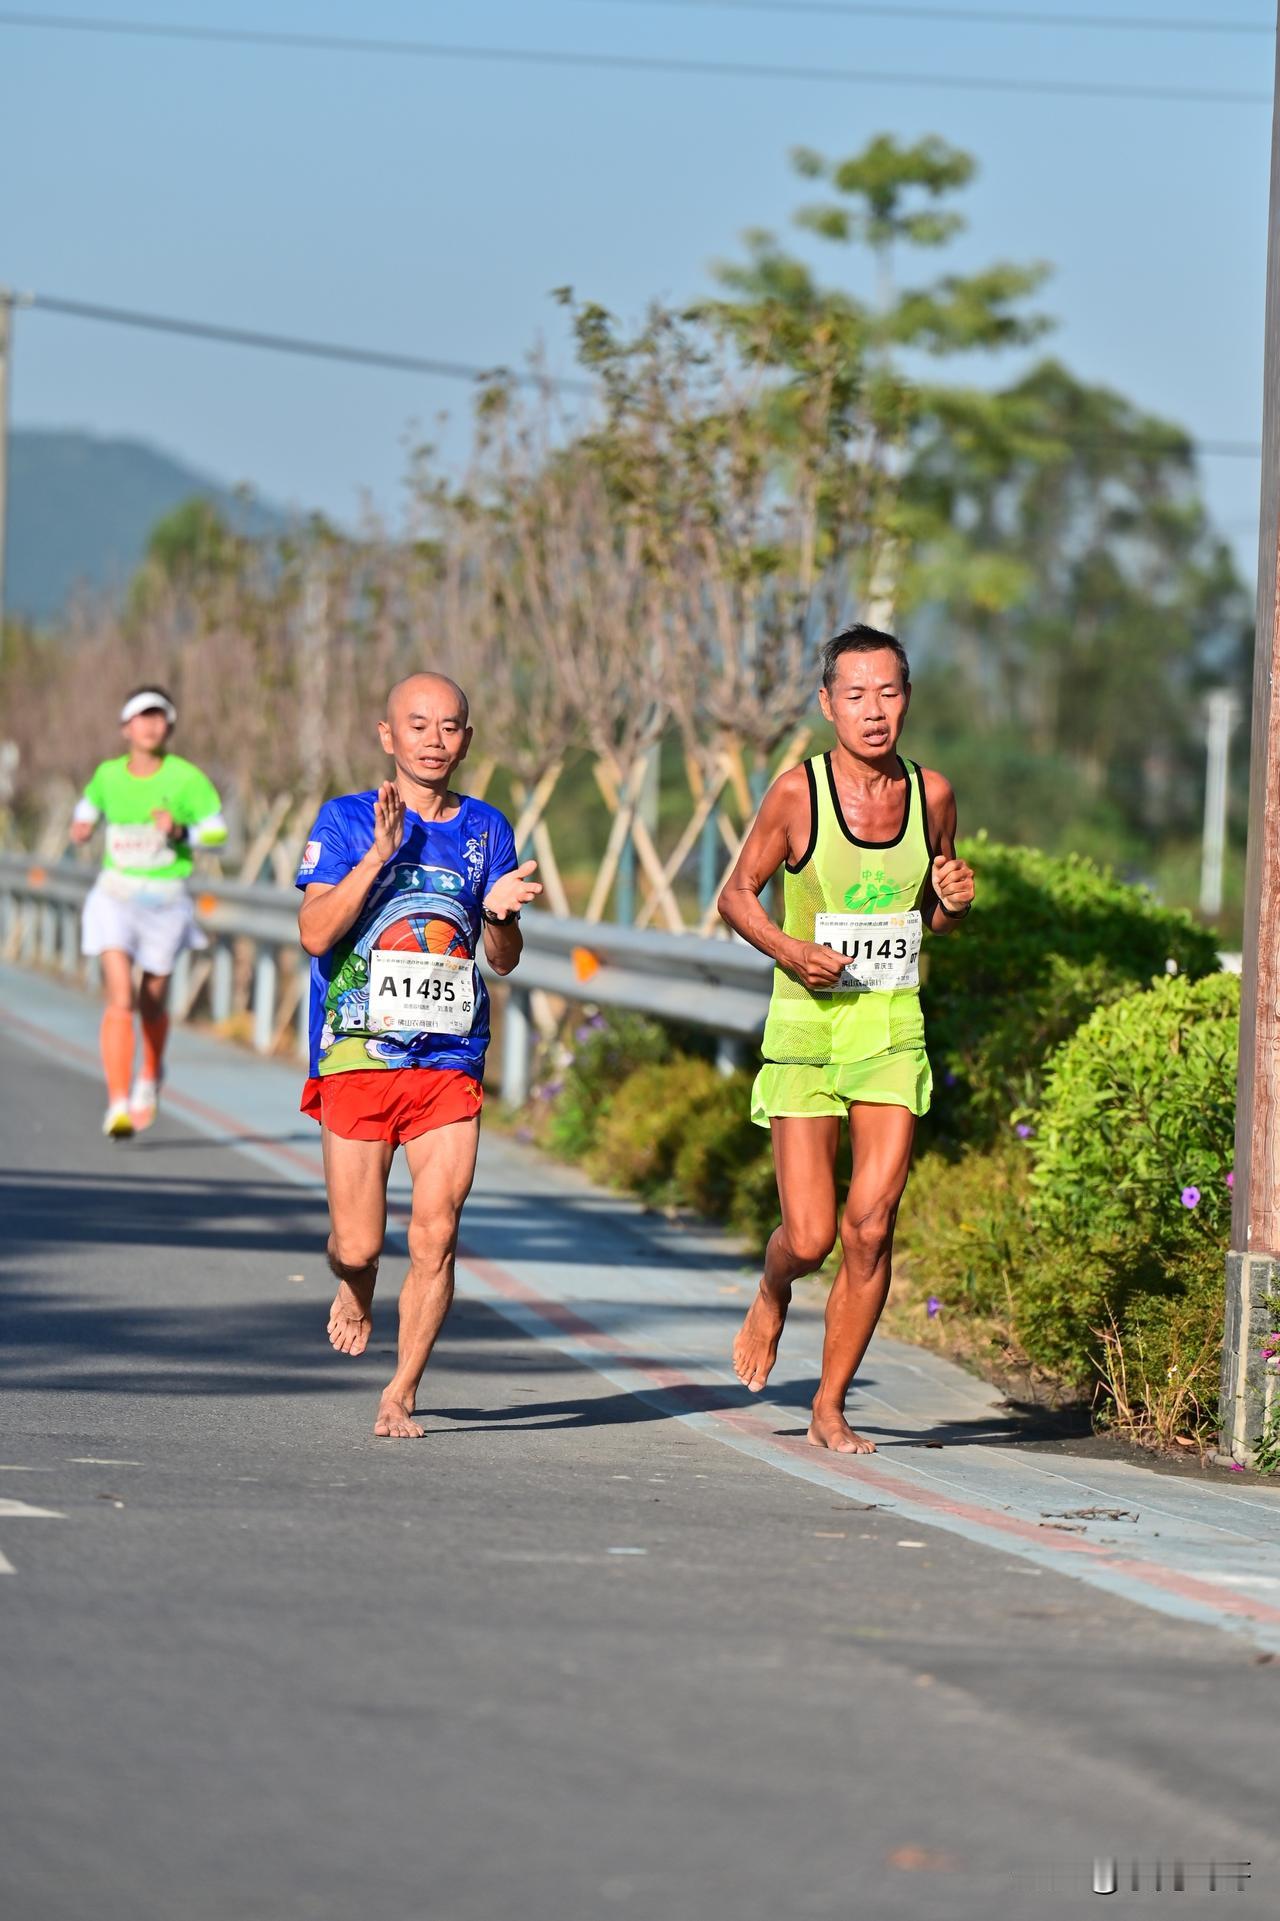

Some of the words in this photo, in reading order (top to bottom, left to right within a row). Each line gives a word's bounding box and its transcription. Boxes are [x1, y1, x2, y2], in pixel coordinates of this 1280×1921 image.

[862, 870, 885, 882] 中华
[379, 976, 456, 1002] A1435
[462, 1001, 471, 1013] 05
